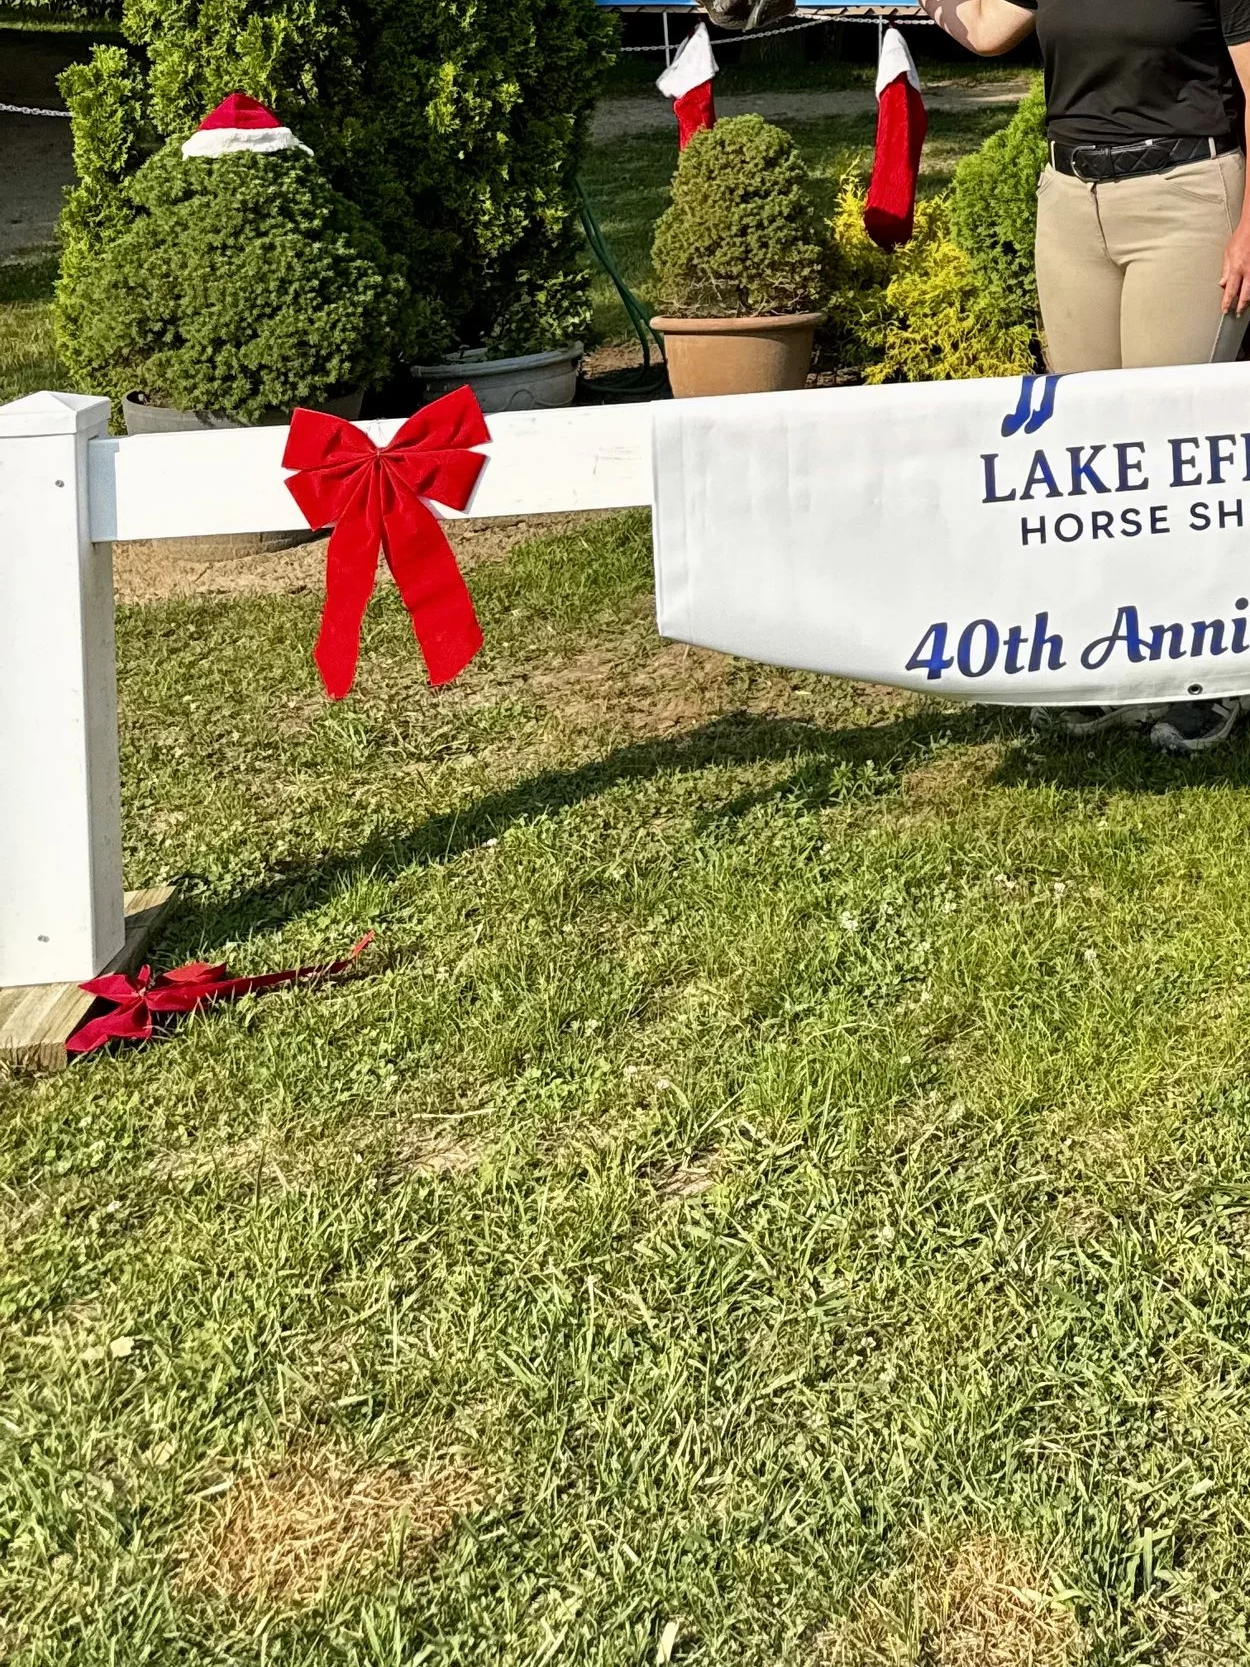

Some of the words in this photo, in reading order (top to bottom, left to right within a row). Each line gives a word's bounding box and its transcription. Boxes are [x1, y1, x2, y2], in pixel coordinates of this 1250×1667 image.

[980, 440, 1150, 504] LAKE
[1021, 505, 1171, 546] HORSE
[905, 611, 1067, 680] 40th
